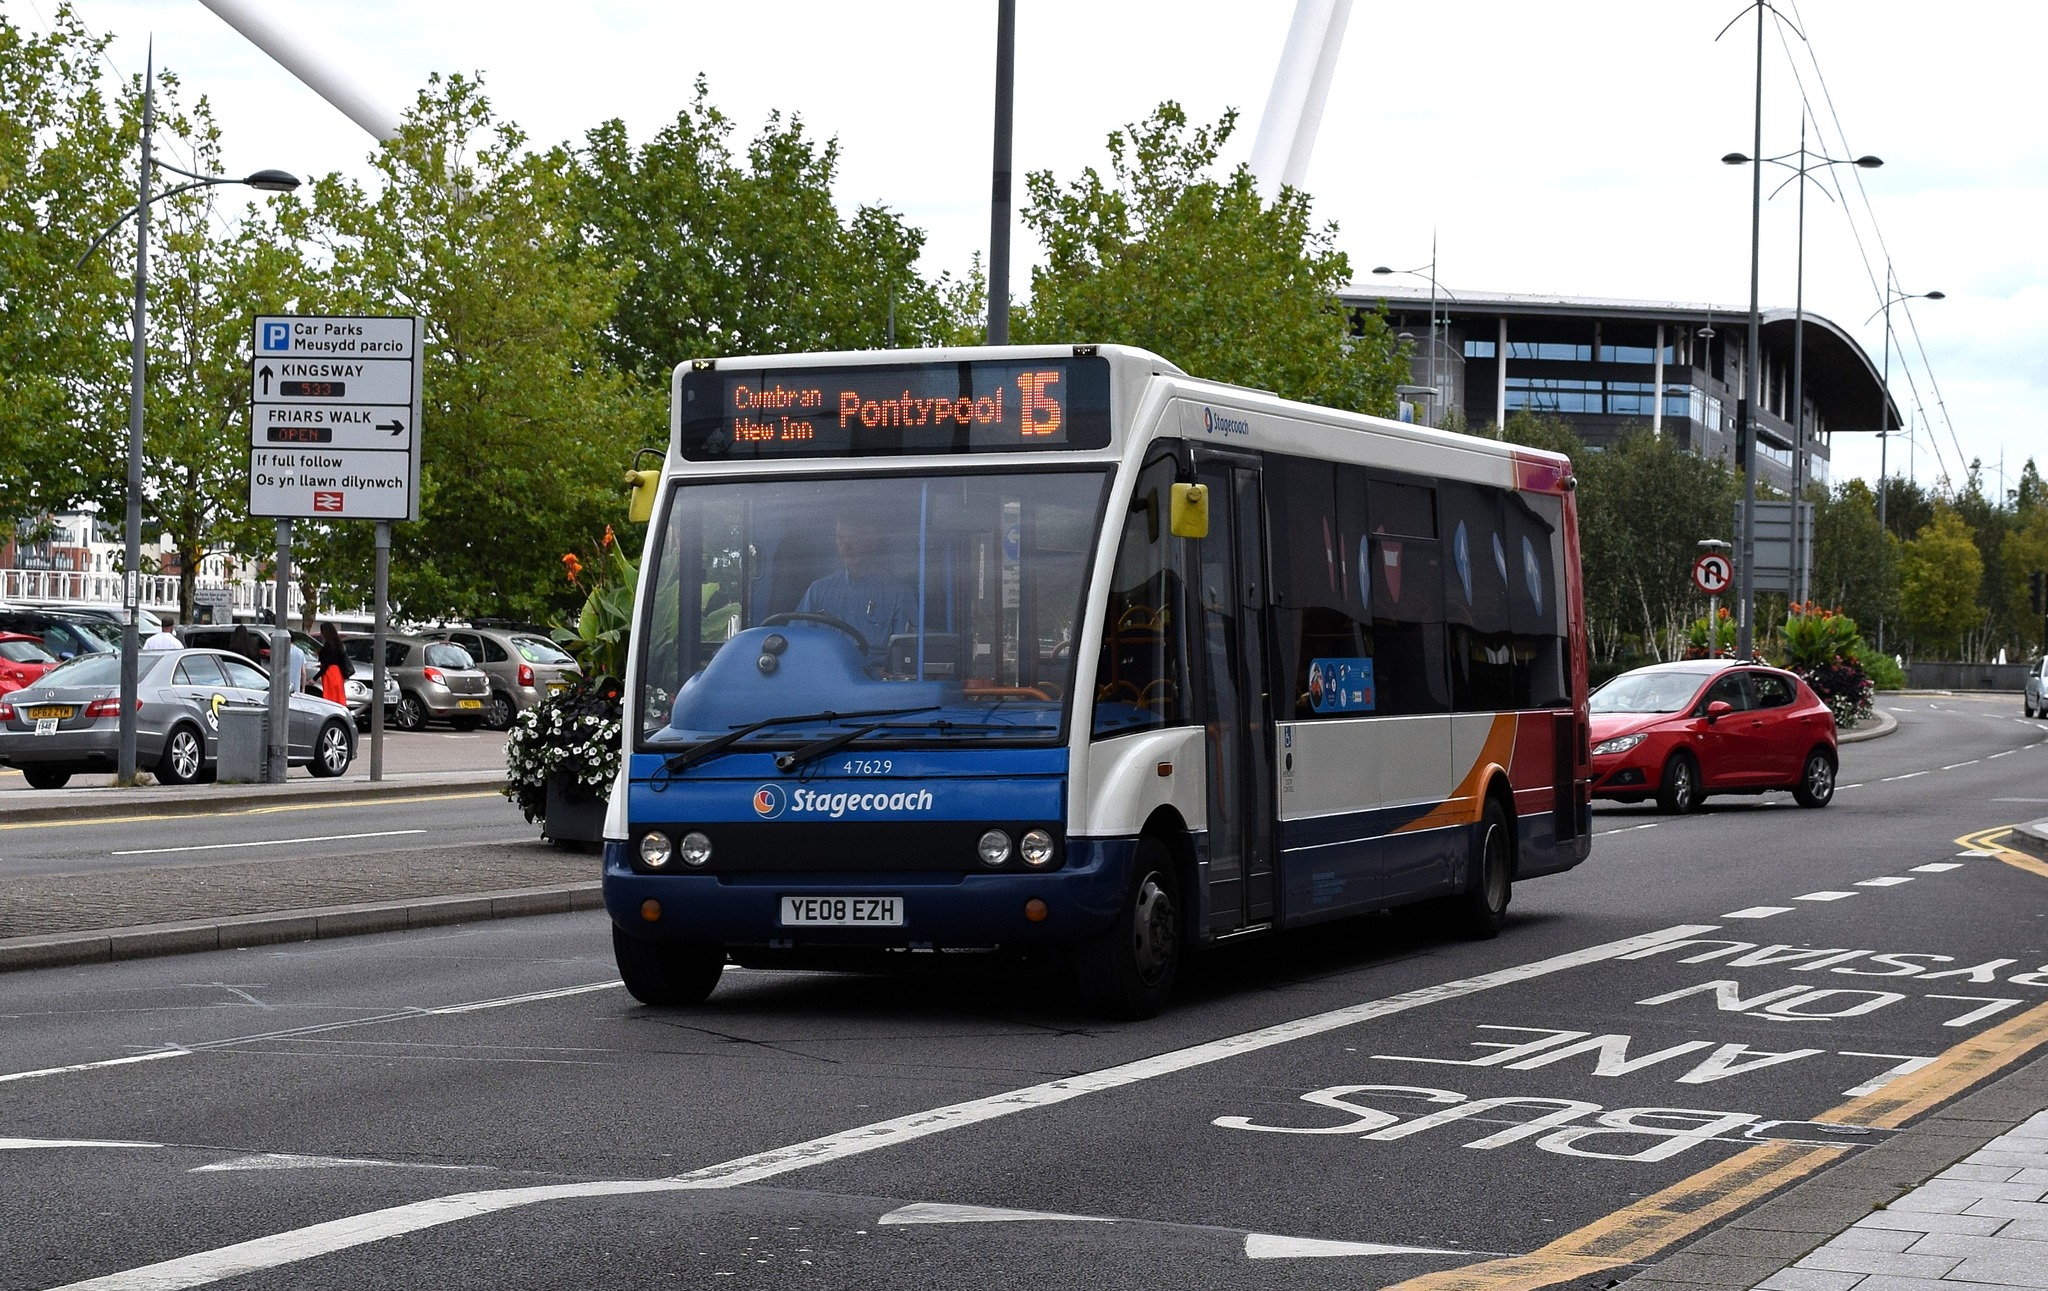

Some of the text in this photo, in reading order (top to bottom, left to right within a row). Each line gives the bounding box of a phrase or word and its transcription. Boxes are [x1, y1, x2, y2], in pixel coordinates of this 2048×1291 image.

[269, 325, 286, 349] P
[294, 323, 363, 336] Car Parks
[294, 338, 403, 353] Meusydd parcio
[281, 364, 364, 377] KINGSWAY
[301, 382, 332, 396] 533
[735, 385, 822, 410] Cwmbran
[839, 387, 1003, 428] Pontypool
[1017, 371, 1062, 435] 15
[268, 410, 372, 423] FRIARS WALK
[1213, 412, 1249, 437] Stagecoach
[278, 428, 318, 441] OPEN
[735, 416, 814, 441] New Inn
[256, 454, 343, 468] If full follow
[256, 473, 403, 490] Os yn llawn dilynwch
[843, 760, 892, 774] 47629
[791, 788, 933, 818] Stagecoach
[791, 900, 894, 920] YE08 EZH
[1369, 1024, 1941, 1097] LANE
[1211, 1084, 1763, 1163] BUS
